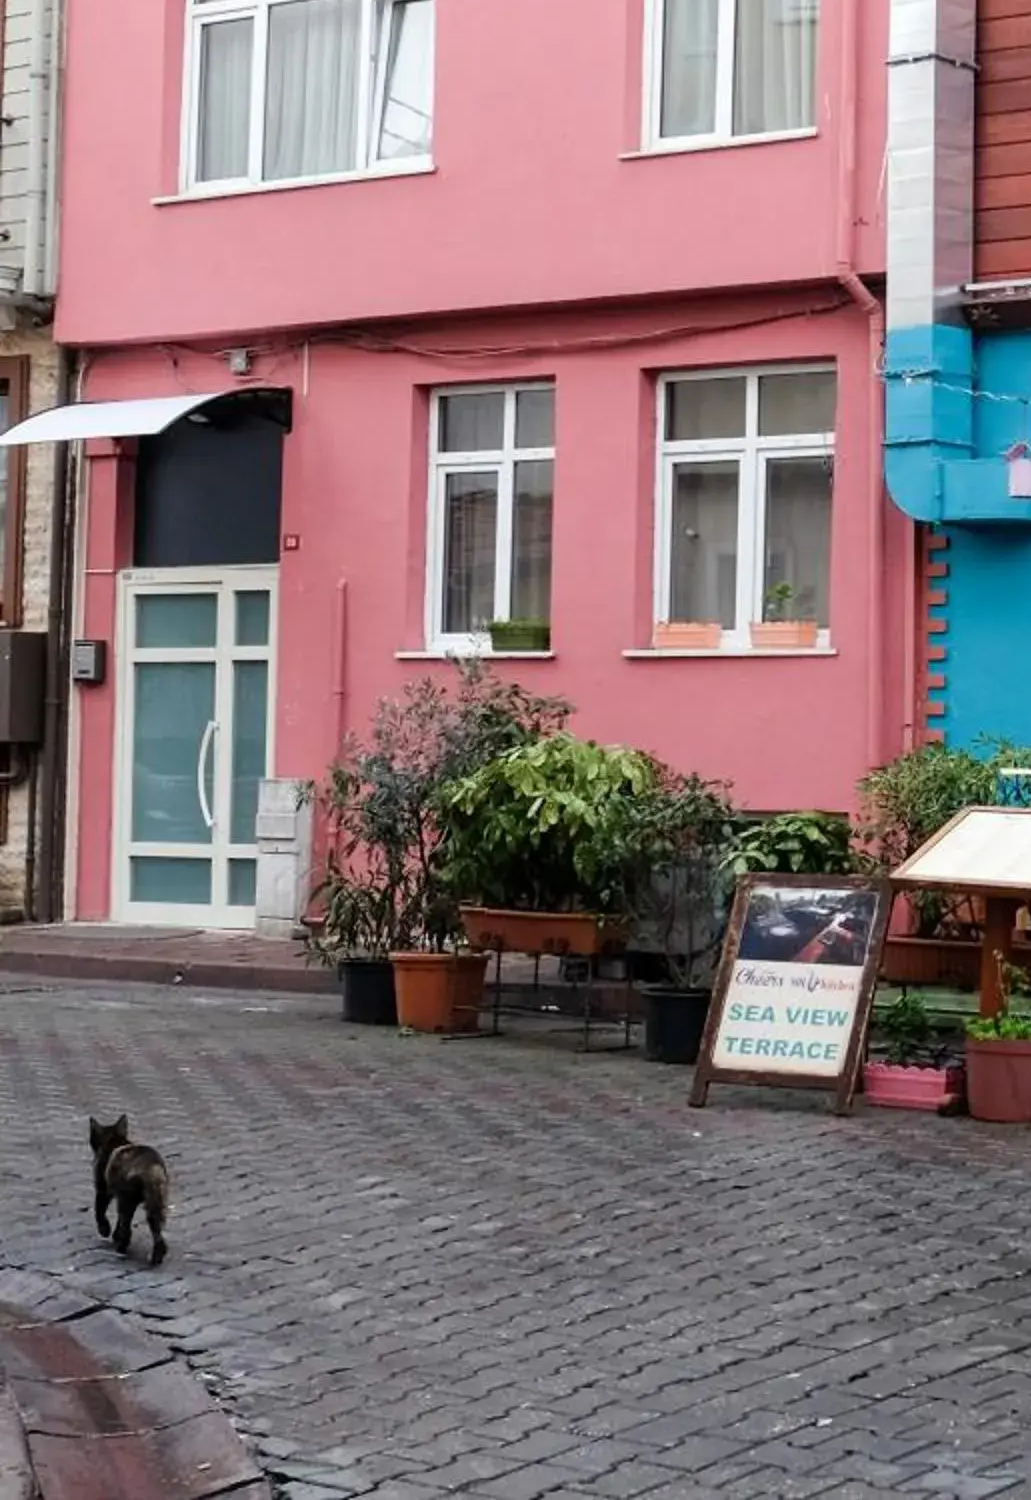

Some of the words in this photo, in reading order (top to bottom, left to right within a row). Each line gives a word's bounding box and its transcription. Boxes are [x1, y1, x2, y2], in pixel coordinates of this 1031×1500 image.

[728, 1002, 775, 1023] SEA
[786, 1005, 849, 1027] VIEW
[725, 1036, 839, 1060] TERRACE
